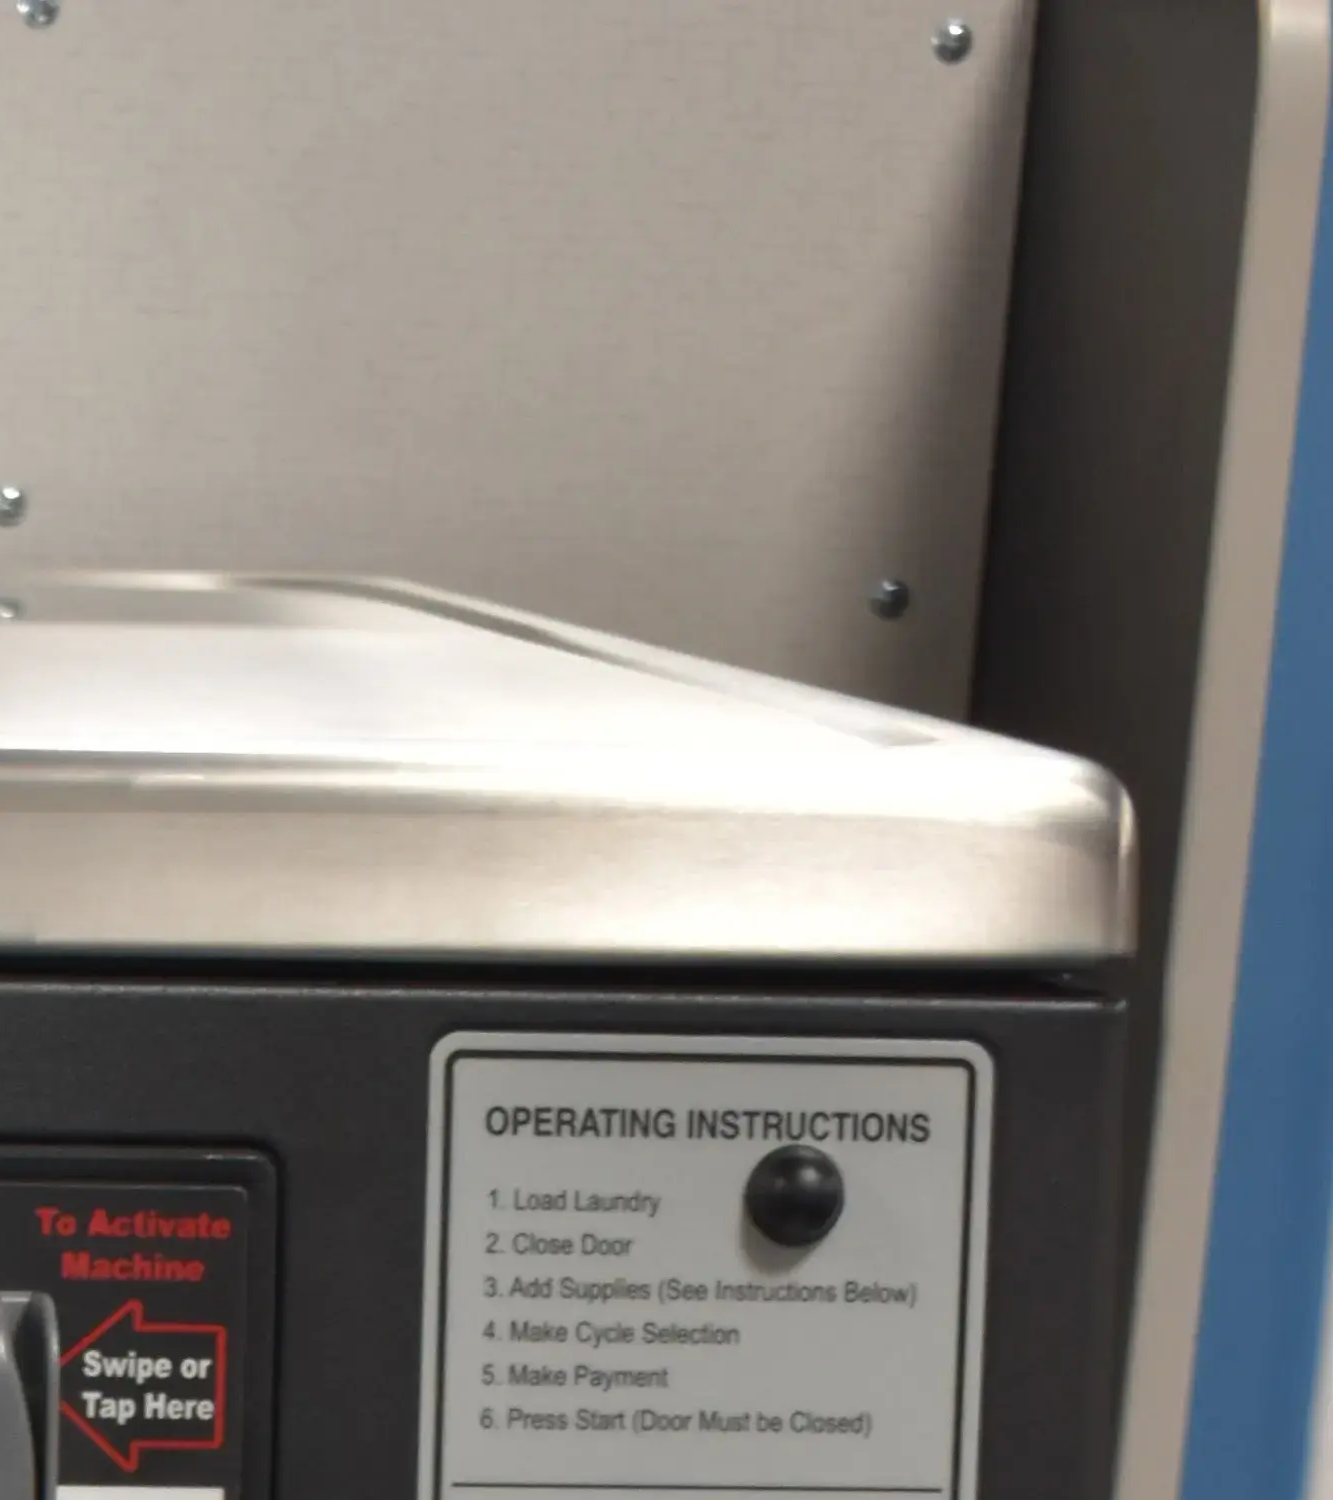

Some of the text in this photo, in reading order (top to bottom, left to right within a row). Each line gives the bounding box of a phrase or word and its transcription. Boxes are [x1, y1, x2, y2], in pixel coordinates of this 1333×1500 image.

[486, 1107, 930, 1144] OPERATING INSTRUCTIONS
[489, 1188, 661, 1217] 1. Load Laundry
[37, 1207, 232, 1239] To Activate
[485, 1232, 633, 1256] 2. Close Door
[61, 1251, 204, 1280] Machine
[484, 1276, 916, 1306] 3. Add Supplies (See Instructions Below)
[482, 1321, 739, 1348] 4. Make Cycle Selection
[83, 1350, 212, 1383] Swipe or
[482, 1364, 668, 1391] 5. Make Payment
[81, 1391, 215, 1425] Tap Here
[480, 1407, 872, 1436] 6. Press Start (Door Must be Closed)
